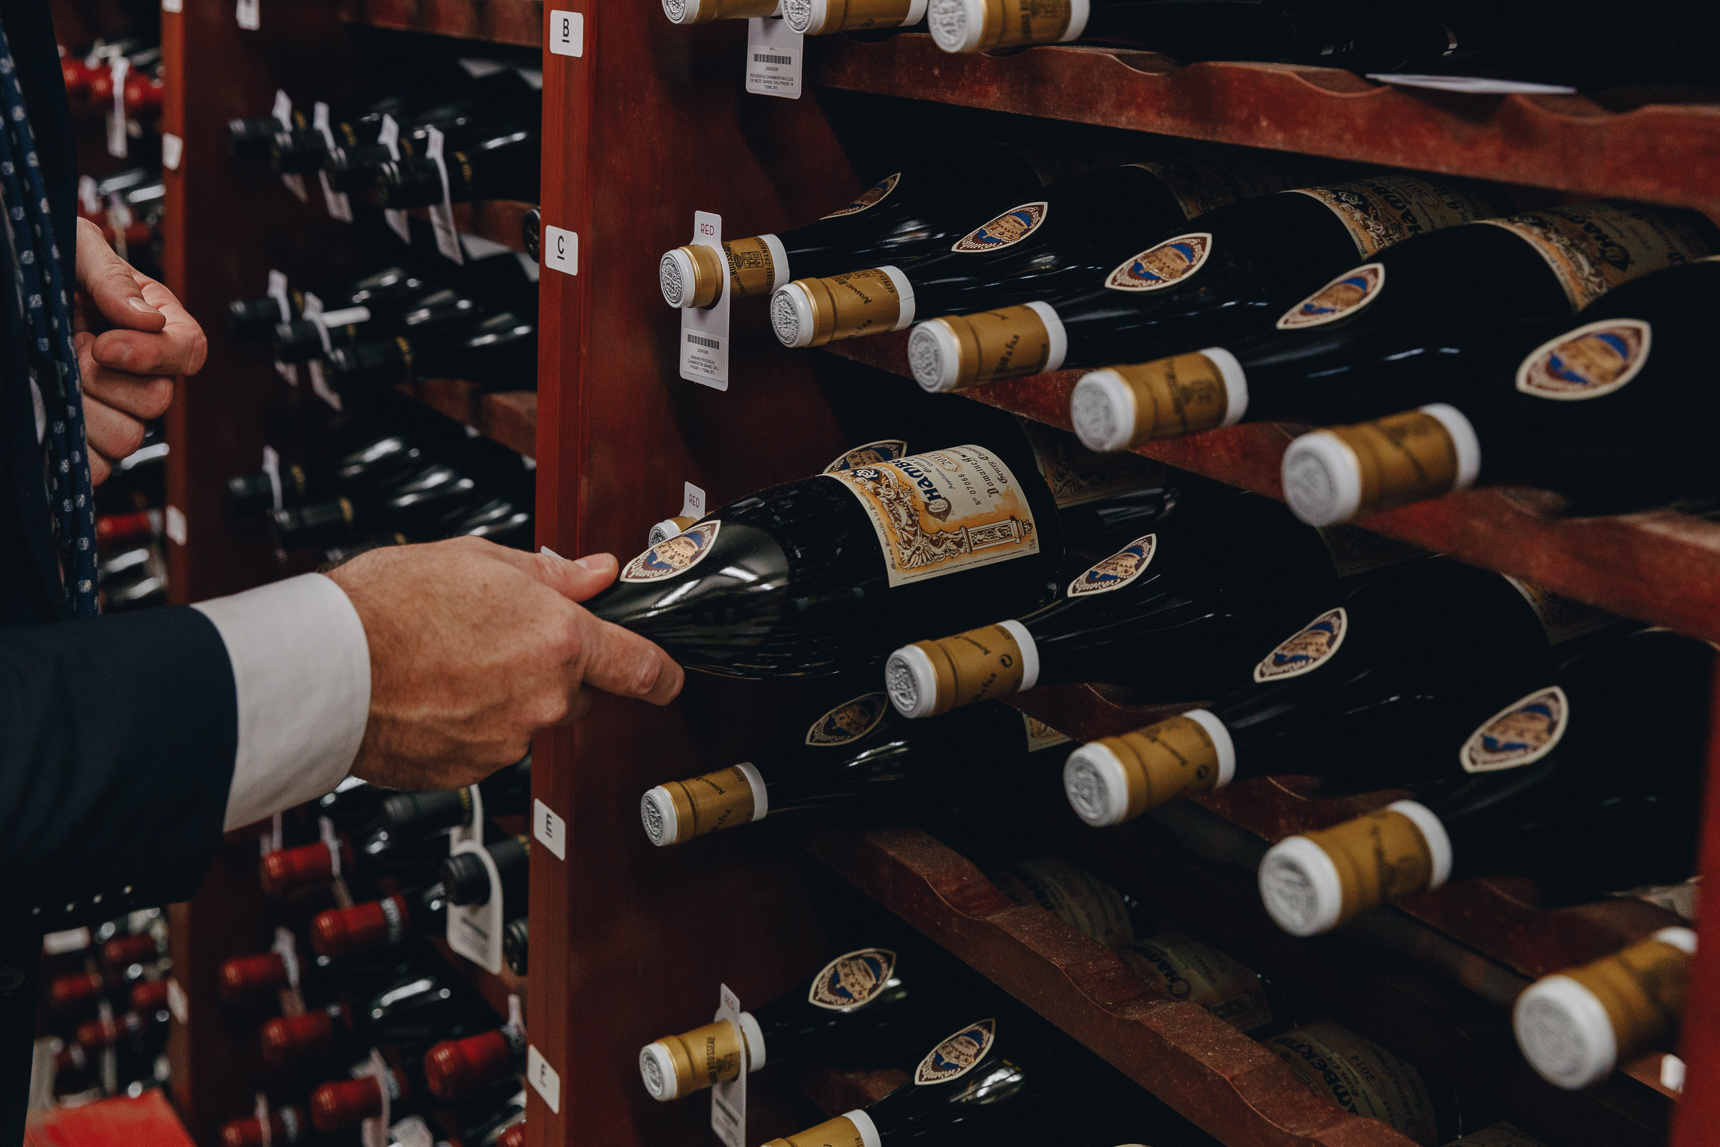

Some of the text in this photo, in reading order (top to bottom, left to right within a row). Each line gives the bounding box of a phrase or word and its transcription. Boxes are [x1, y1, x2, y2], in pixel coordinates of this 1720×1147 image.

[562, 18, 570, 38] B
[700, 223, 714, 236] RED
[558, 235, 564, 254] C
[972, 460, 1001, 500] Domaine
[689, 494, 700, 508] RED
[546, 813, 552, 832] E
